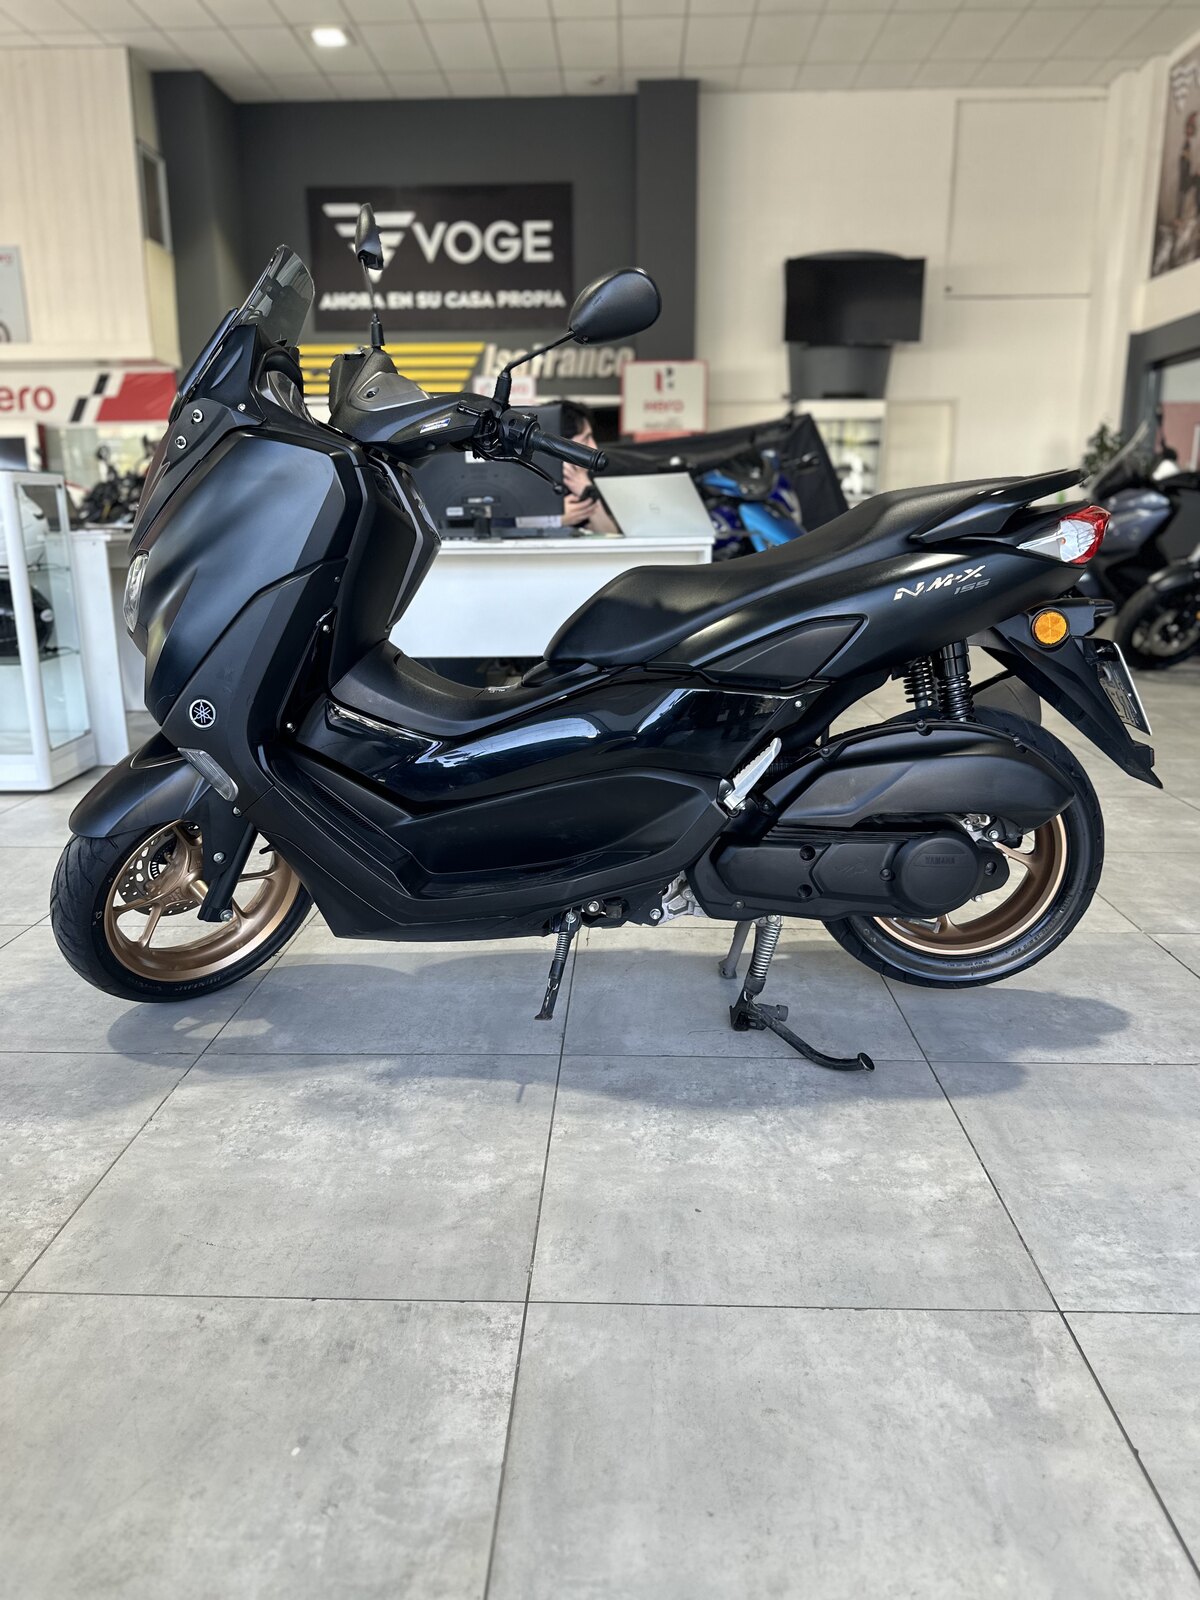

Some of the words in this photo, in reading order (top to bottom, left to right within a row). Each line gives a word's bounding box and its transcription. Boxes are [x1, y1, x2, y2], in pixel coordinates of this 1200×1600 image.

[411, 220, 554, 264] VOGE
[319, 293, 386, 310] AHORA
[387, 292, 413, 309] EN
[416, 291, 442, 308] SU
[444, 290, 495, 308] CASA
[496, 290, 567, 307] PROPIA
[954, 578, 991, 595] 155
[925, 856, 955, 865] YAMAHA
